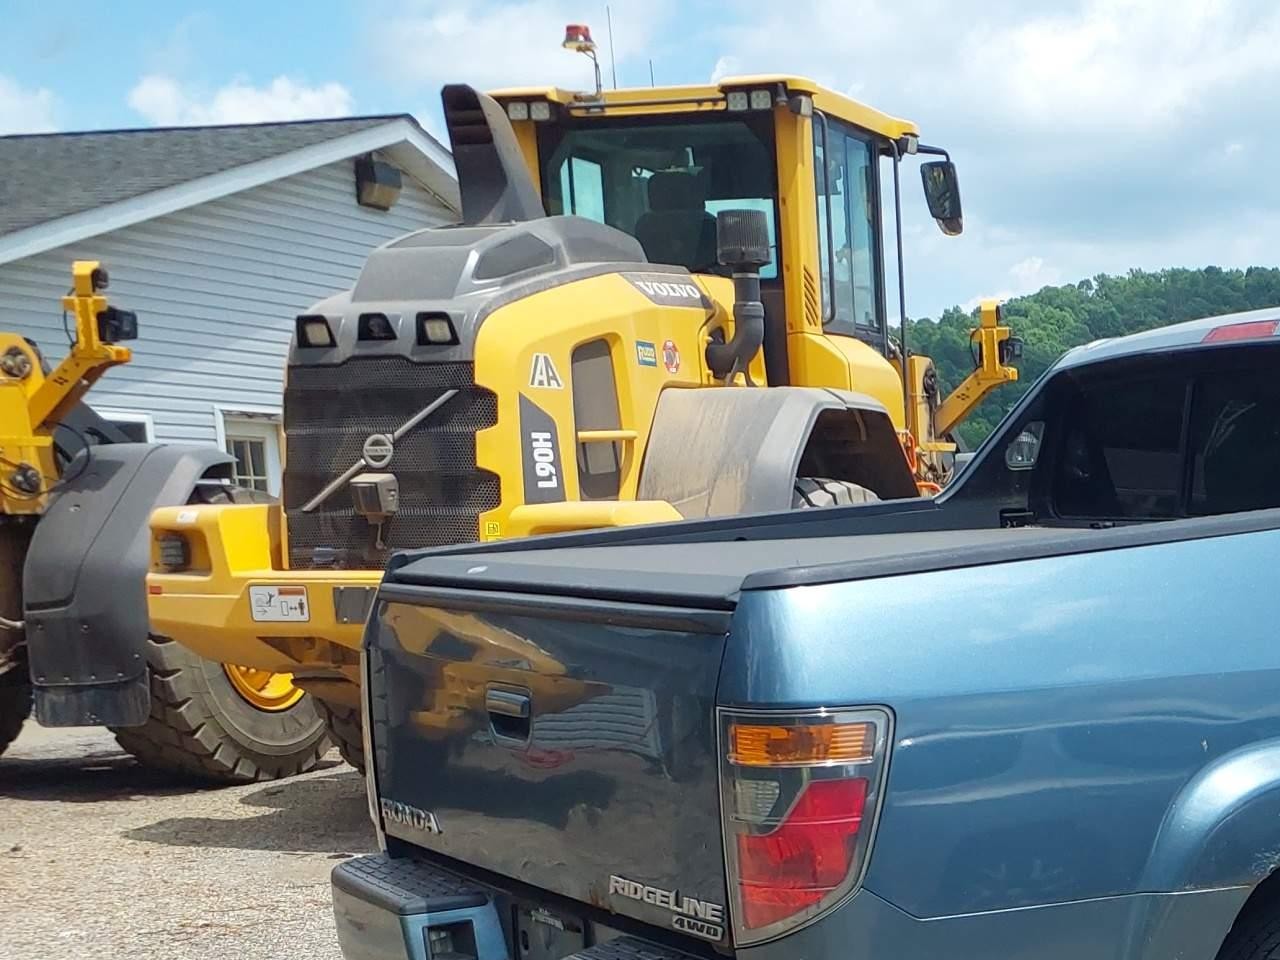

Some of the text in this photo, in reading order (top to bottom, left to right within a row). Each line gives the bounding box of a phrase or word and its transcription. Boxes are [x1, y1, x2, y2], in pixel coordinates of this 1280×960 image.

[635, 281, 700, 298] VOLVO
[531, 432, 558, 488] L90H
[380, 797, 442, 833] HONDA
[609, 874, 723, 922] RIDGELINE
[673, 916, 719, 937] 4WD
